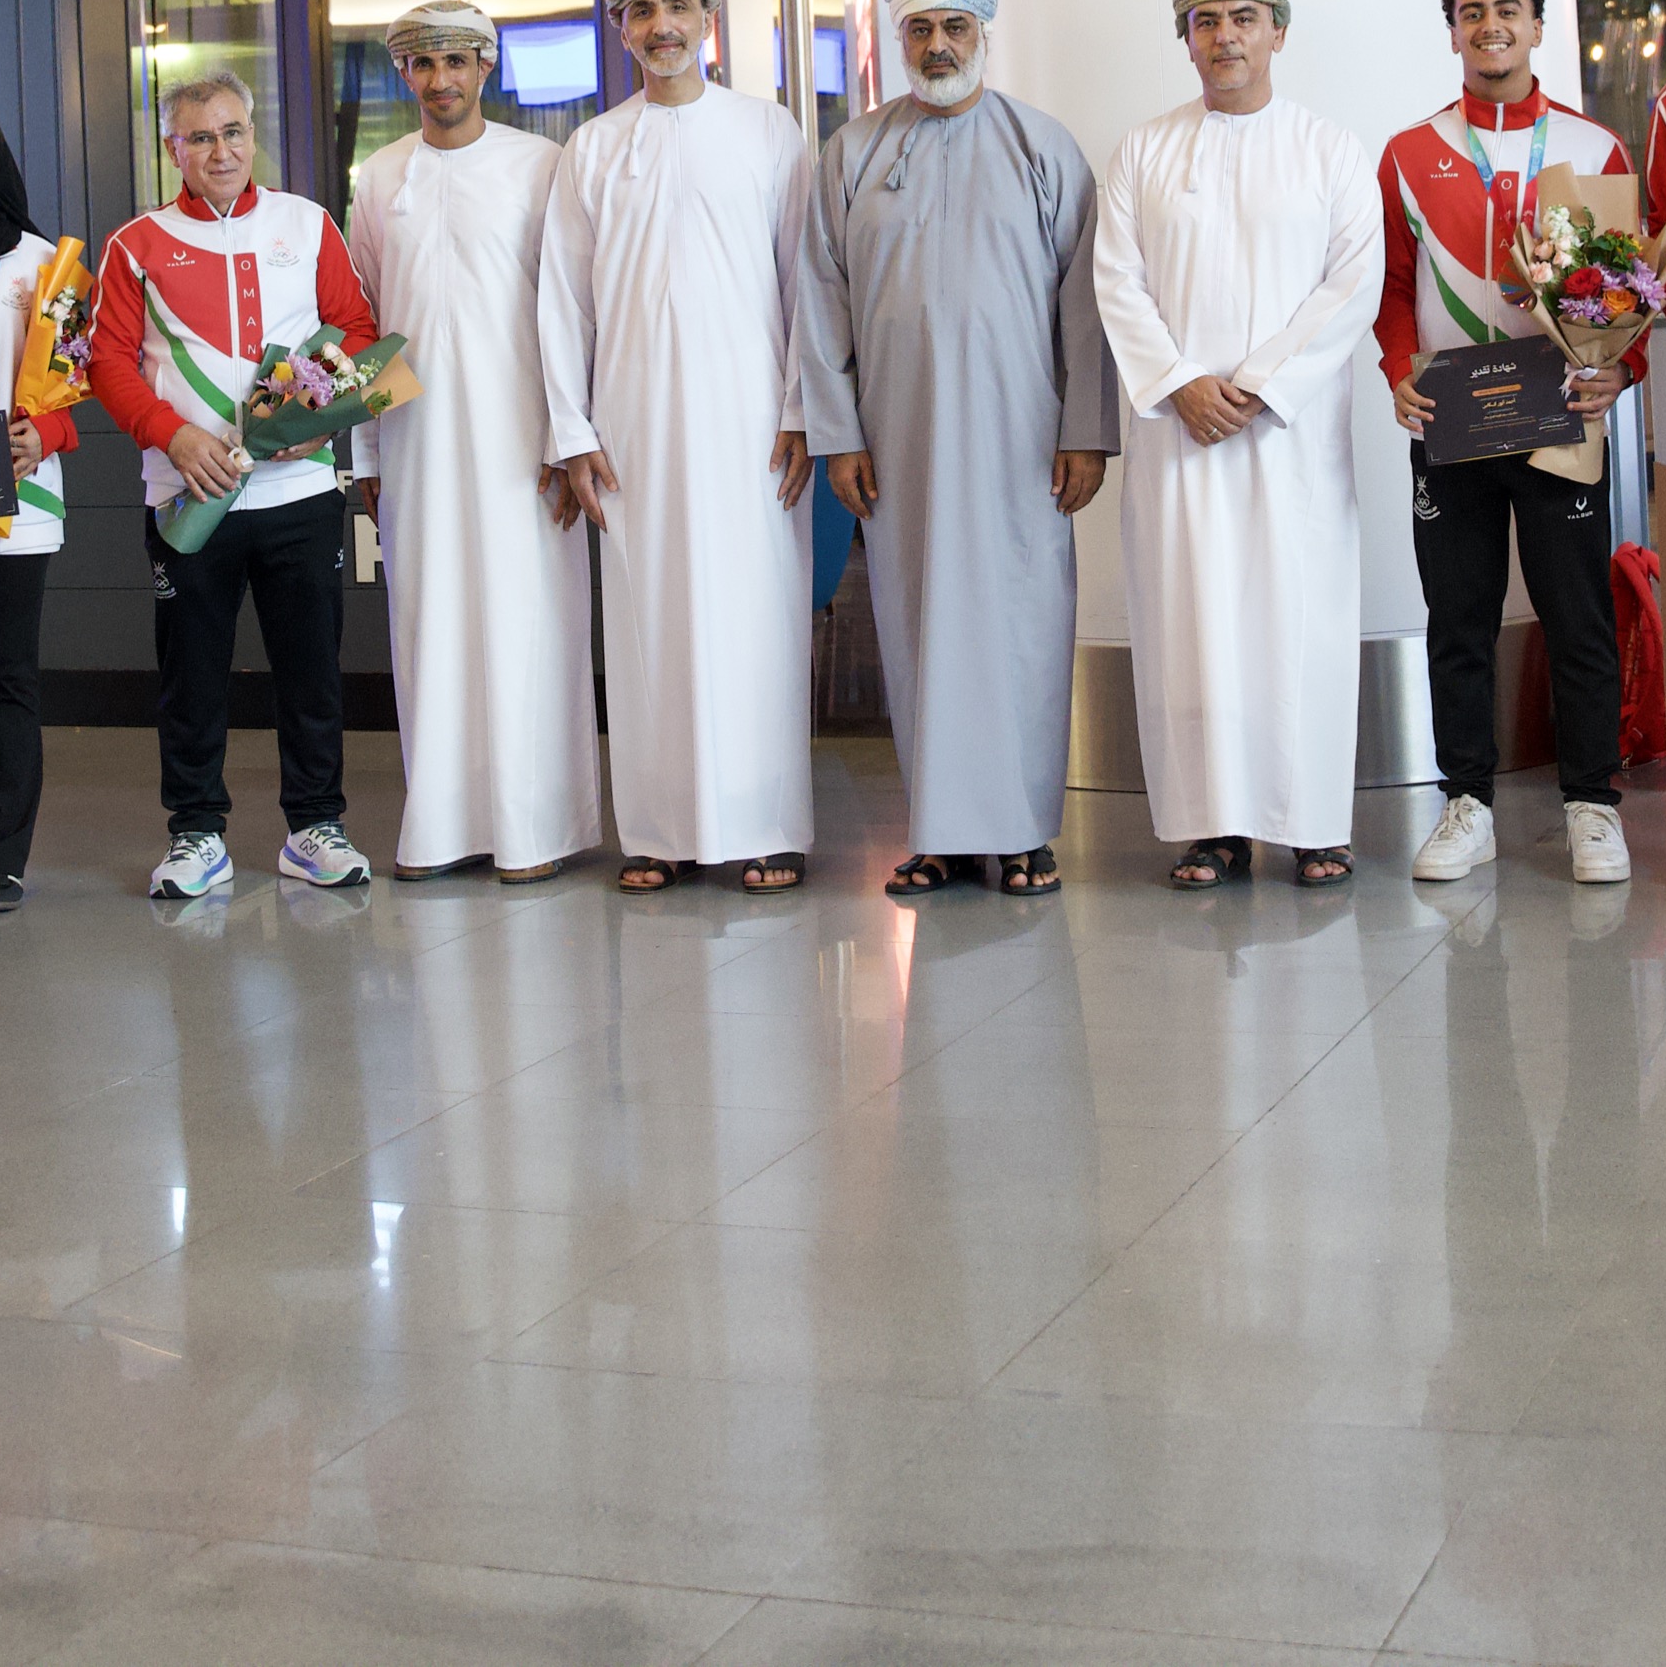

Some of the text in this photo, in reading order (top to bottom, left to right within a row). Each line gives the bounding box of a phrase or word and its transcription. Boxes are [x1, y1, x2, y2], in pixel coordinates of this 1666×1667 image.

[240, 259, 257, 355] OMAN
[1492, 361, 1517, 373] شهادة
[1567, 510, 1594, 521] VALOUR
